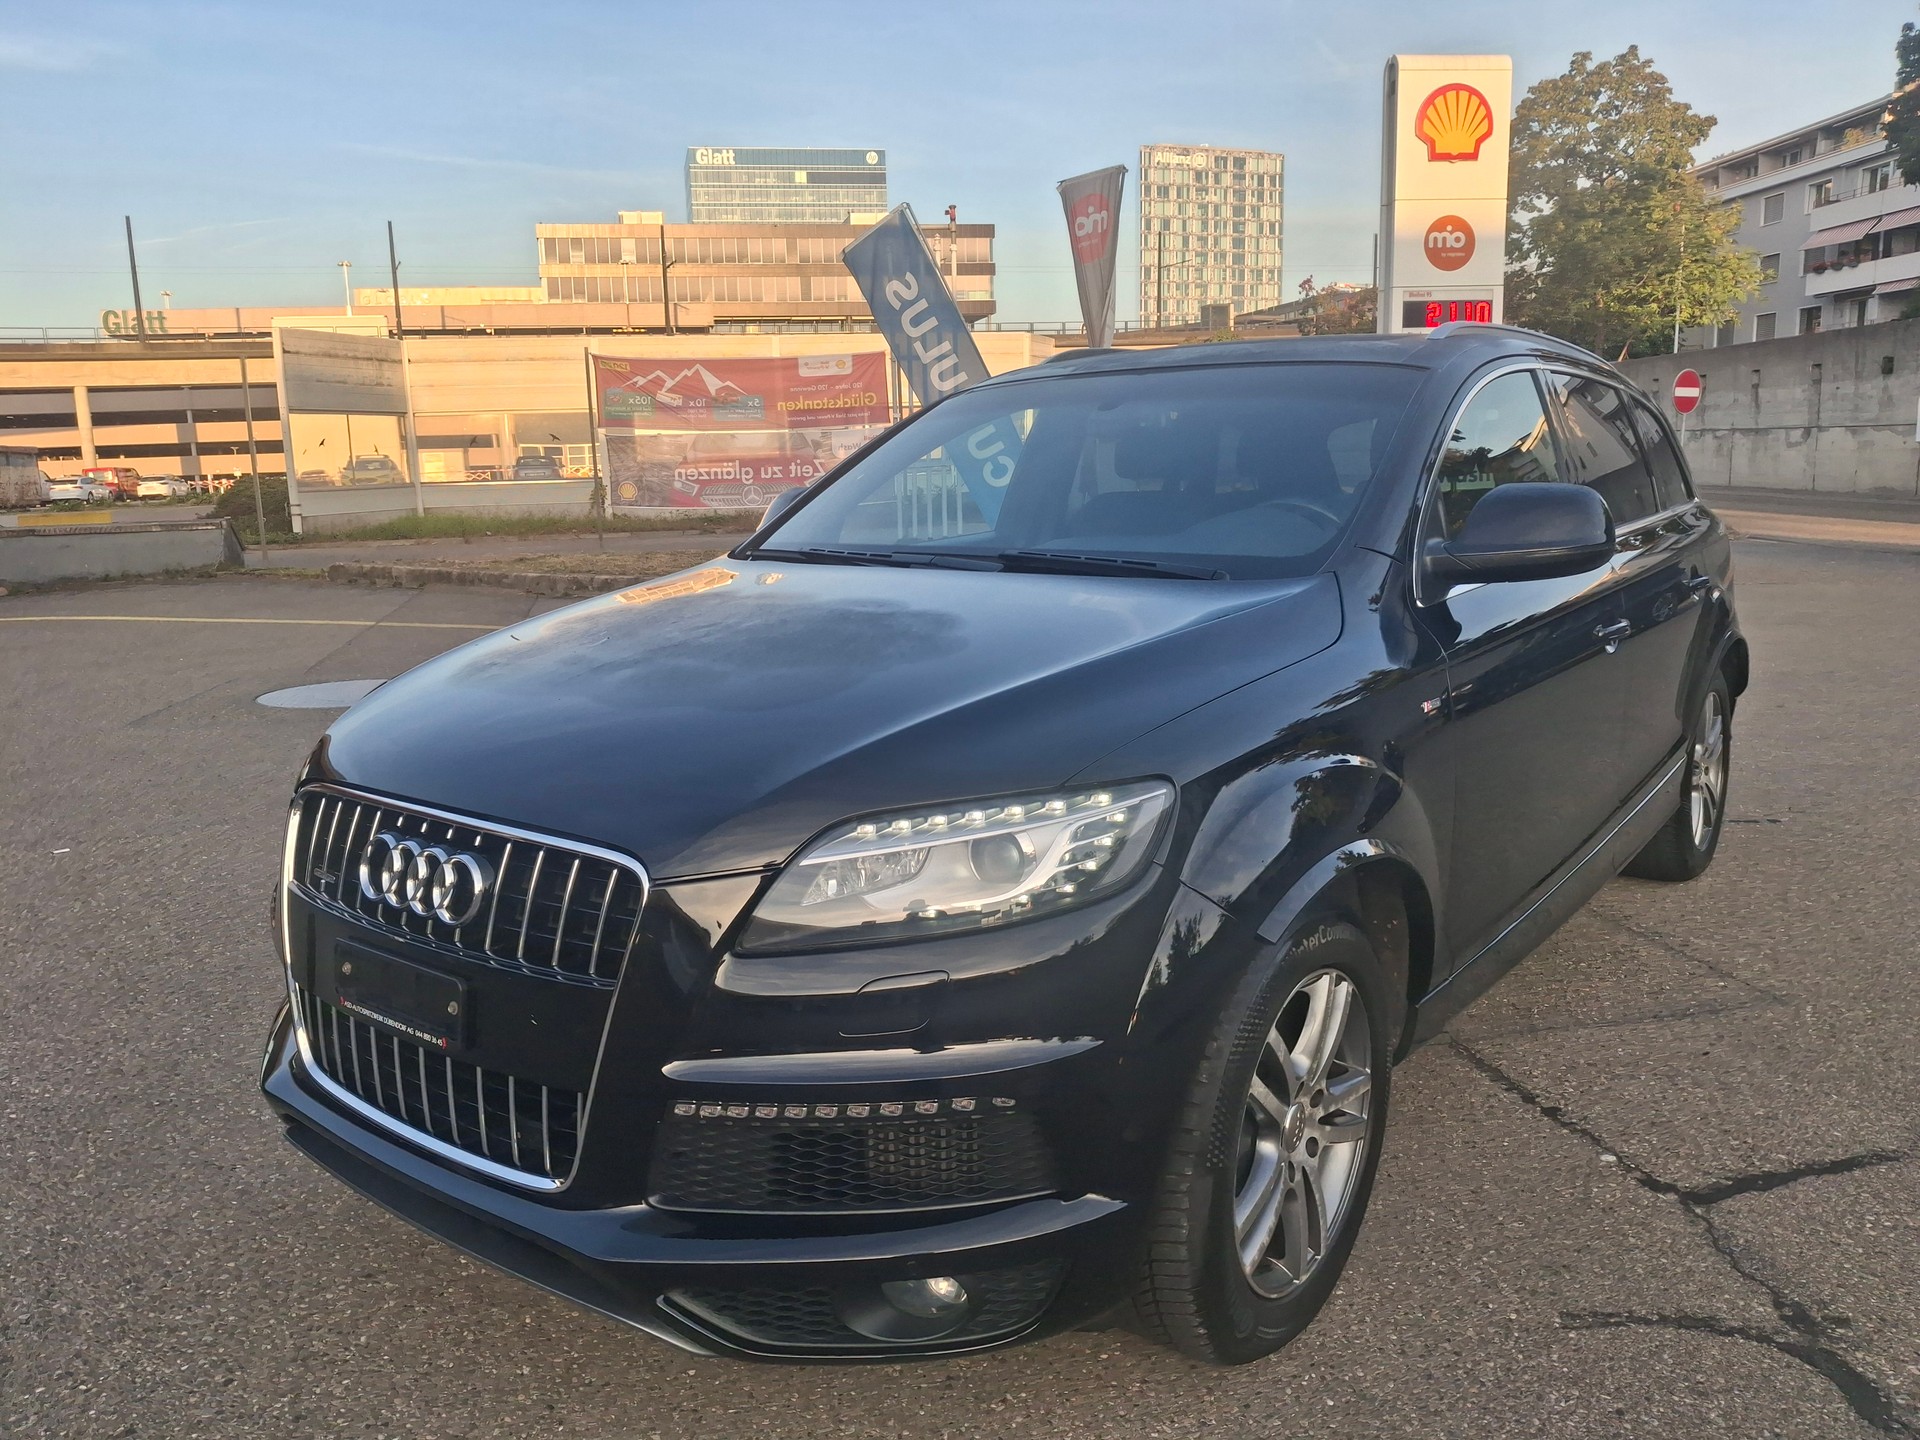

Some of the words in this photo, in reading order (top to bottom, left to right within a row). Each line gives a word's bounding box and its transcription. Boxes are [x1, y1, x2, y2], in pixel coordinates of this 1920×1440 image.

[695, 149, 736, 165] Glatt
[1155, 152, 1192, 165] Allianz
[1428, 225, 1466, 248] mio
